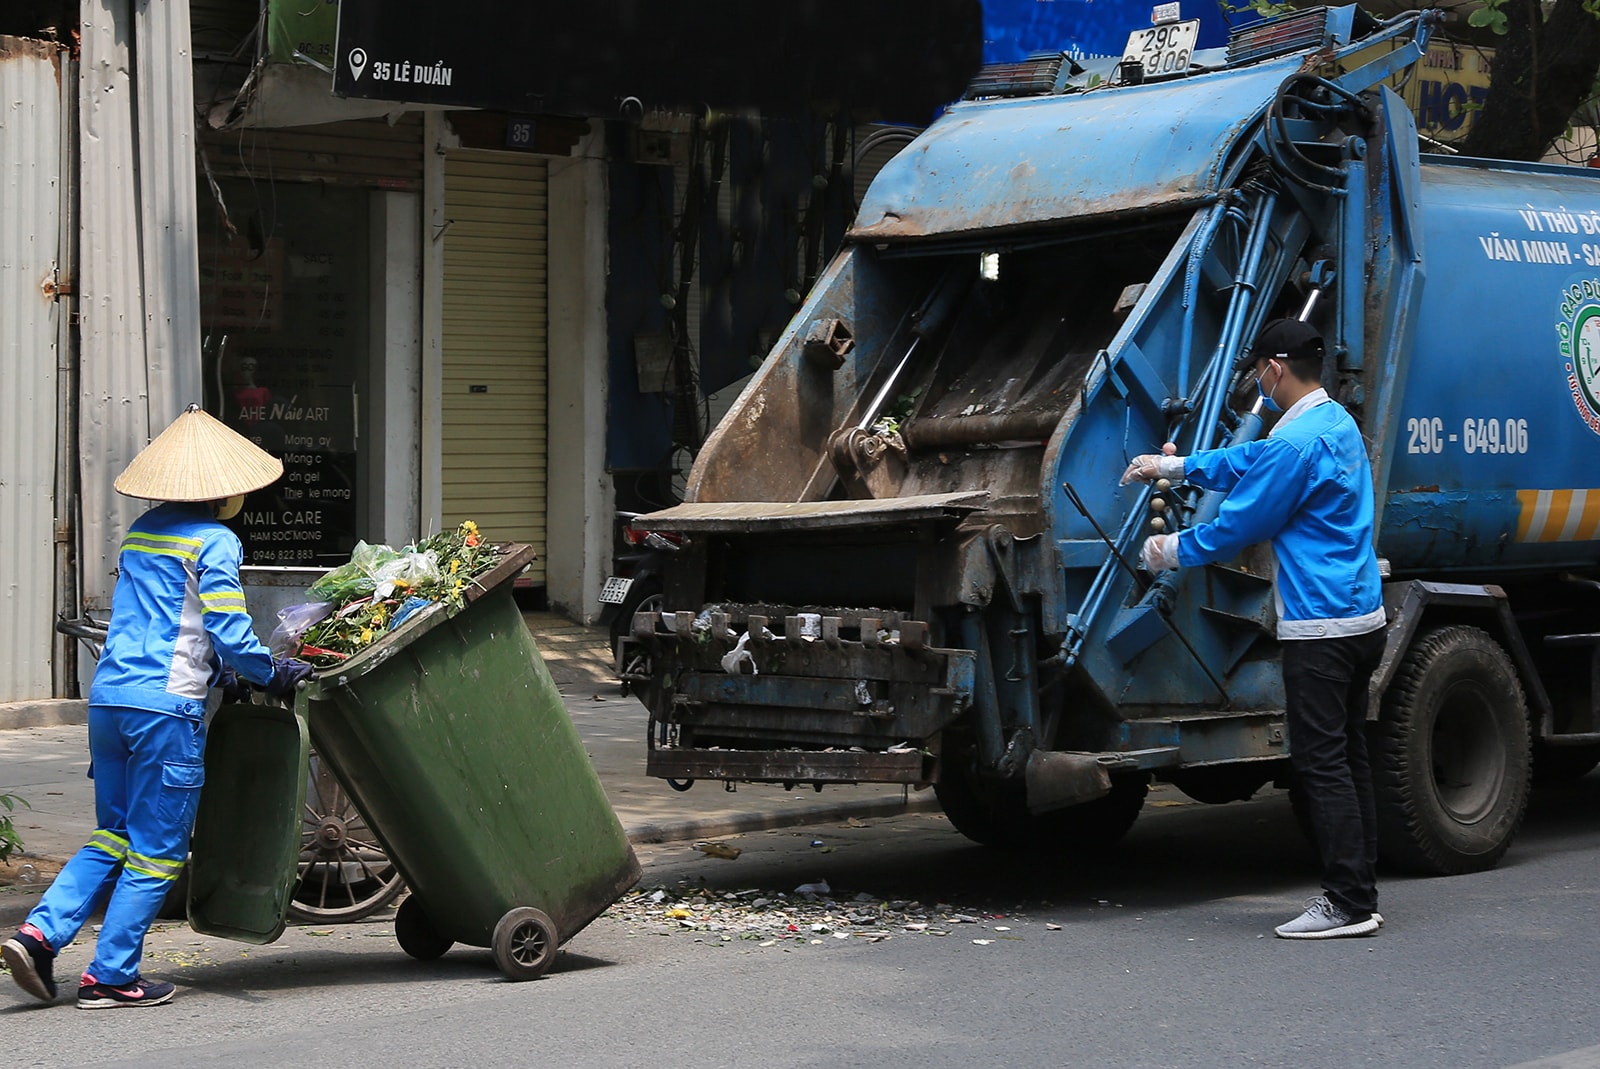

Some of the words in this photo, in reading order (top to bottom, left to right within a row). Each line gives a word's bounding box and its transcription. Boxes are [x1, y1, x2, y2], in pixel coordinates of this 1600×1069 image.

[318, 43, 330, 55] 35
[1142, 25, 1181, 52] 29C
[373, 61, 391, 81] 35
[393, 60, 411, 83] LÊ
[413, 60, 453, 86] DUẨN
[1124, 48, 1189, 75] 9.06
[512, 123, 531, 143] 35
[1518, 202, 1544, 232] VÌ
[1540, 205, 1579, 235] THỦ
[1478, 231, 1522, 263] VĂN
[1521, 239, 1573, 265] MINH
[1560, 283, 1583, 323] RÁC
[238, 406, 266, 421] AHE
[269, 402, 303, 421] Nail
[304, 407, 330, 422] ART
[1407, 416, 1444, 454] 29C
[1463, 417, 1529, 455] 649.06
[304, 471, 320, 485] gel
[243, 511, 278, 526] NAIL
[282, 510, 322, 525] CARE
[252, 550, 276, 561] 0946
[277, 550, 295, 561] 822
[297, 549, 314, 560] 883
